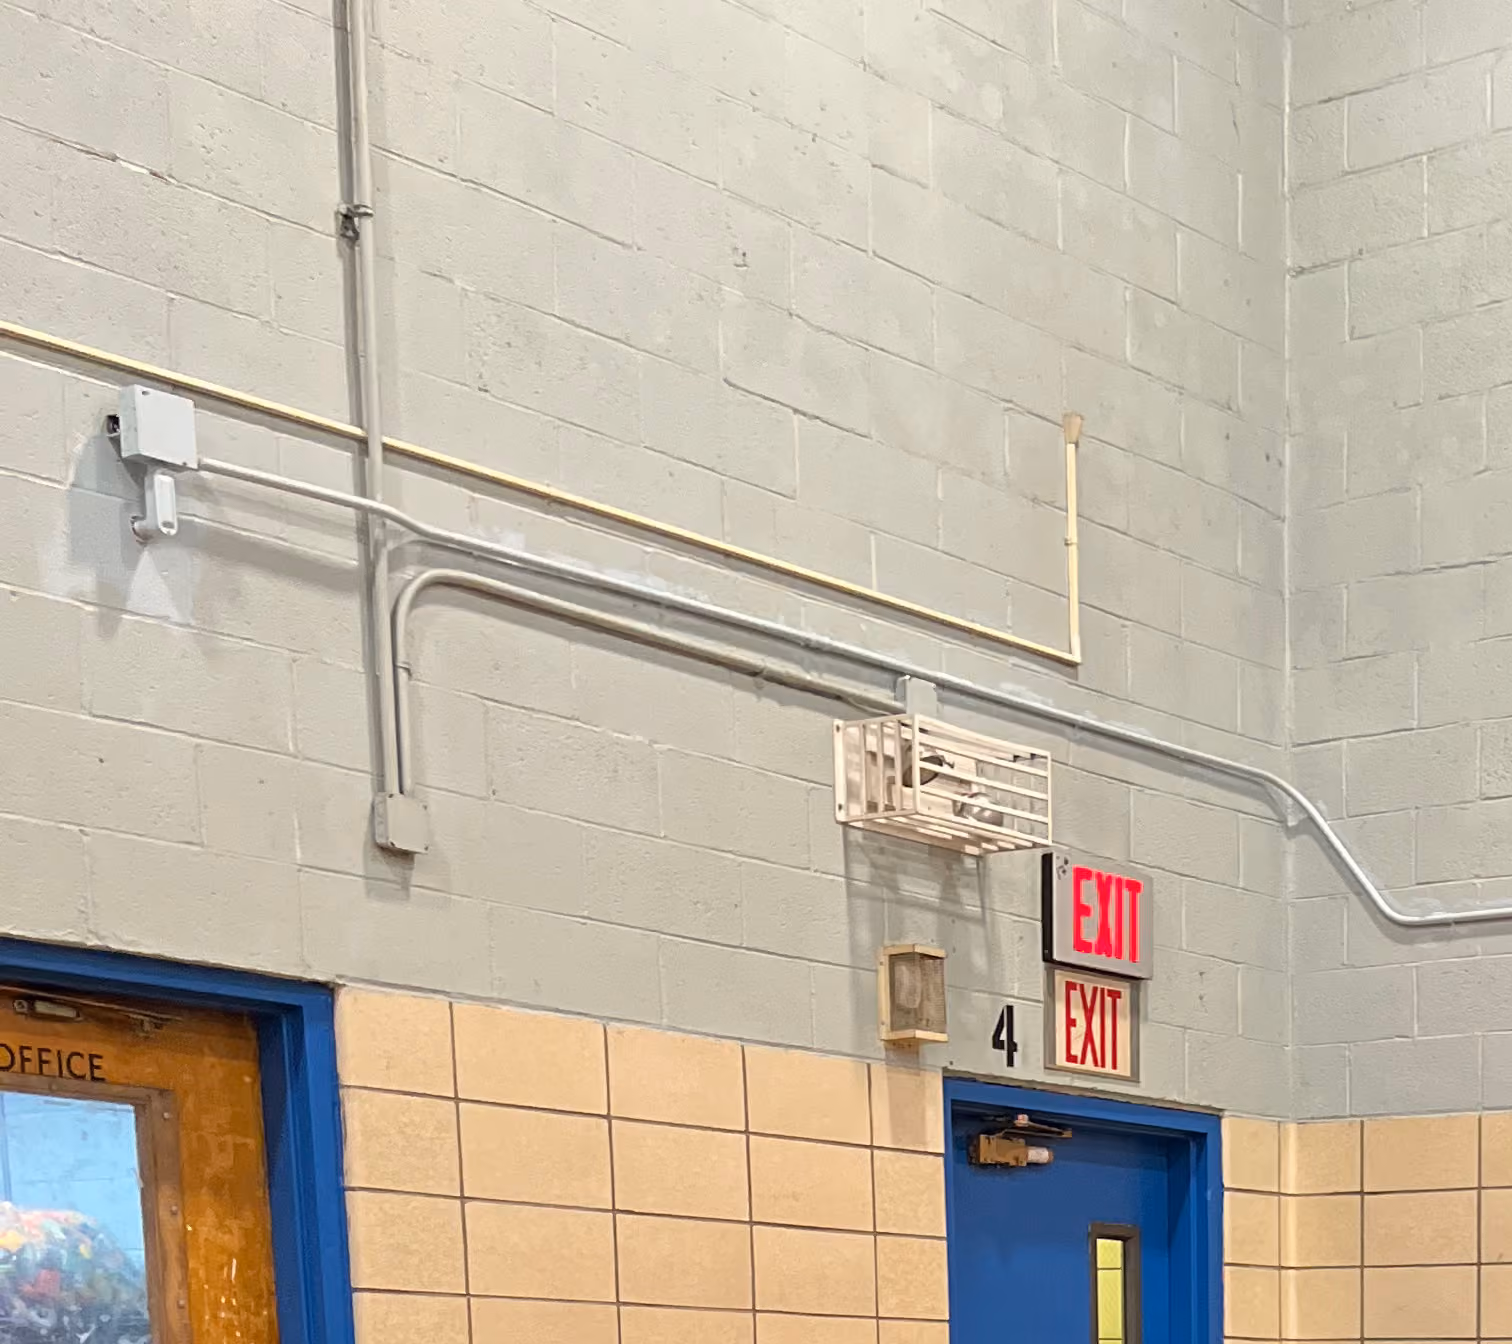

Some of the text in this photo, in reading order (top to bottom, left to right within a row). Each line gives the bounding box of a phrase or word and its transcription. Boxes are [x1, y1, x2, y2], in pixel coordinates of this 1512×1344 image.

[1072, 863, 1145, 963] EXIT
[992, 1004, 1018, 1067] 4
[1065, 980, 1121, 1070] EXIT
